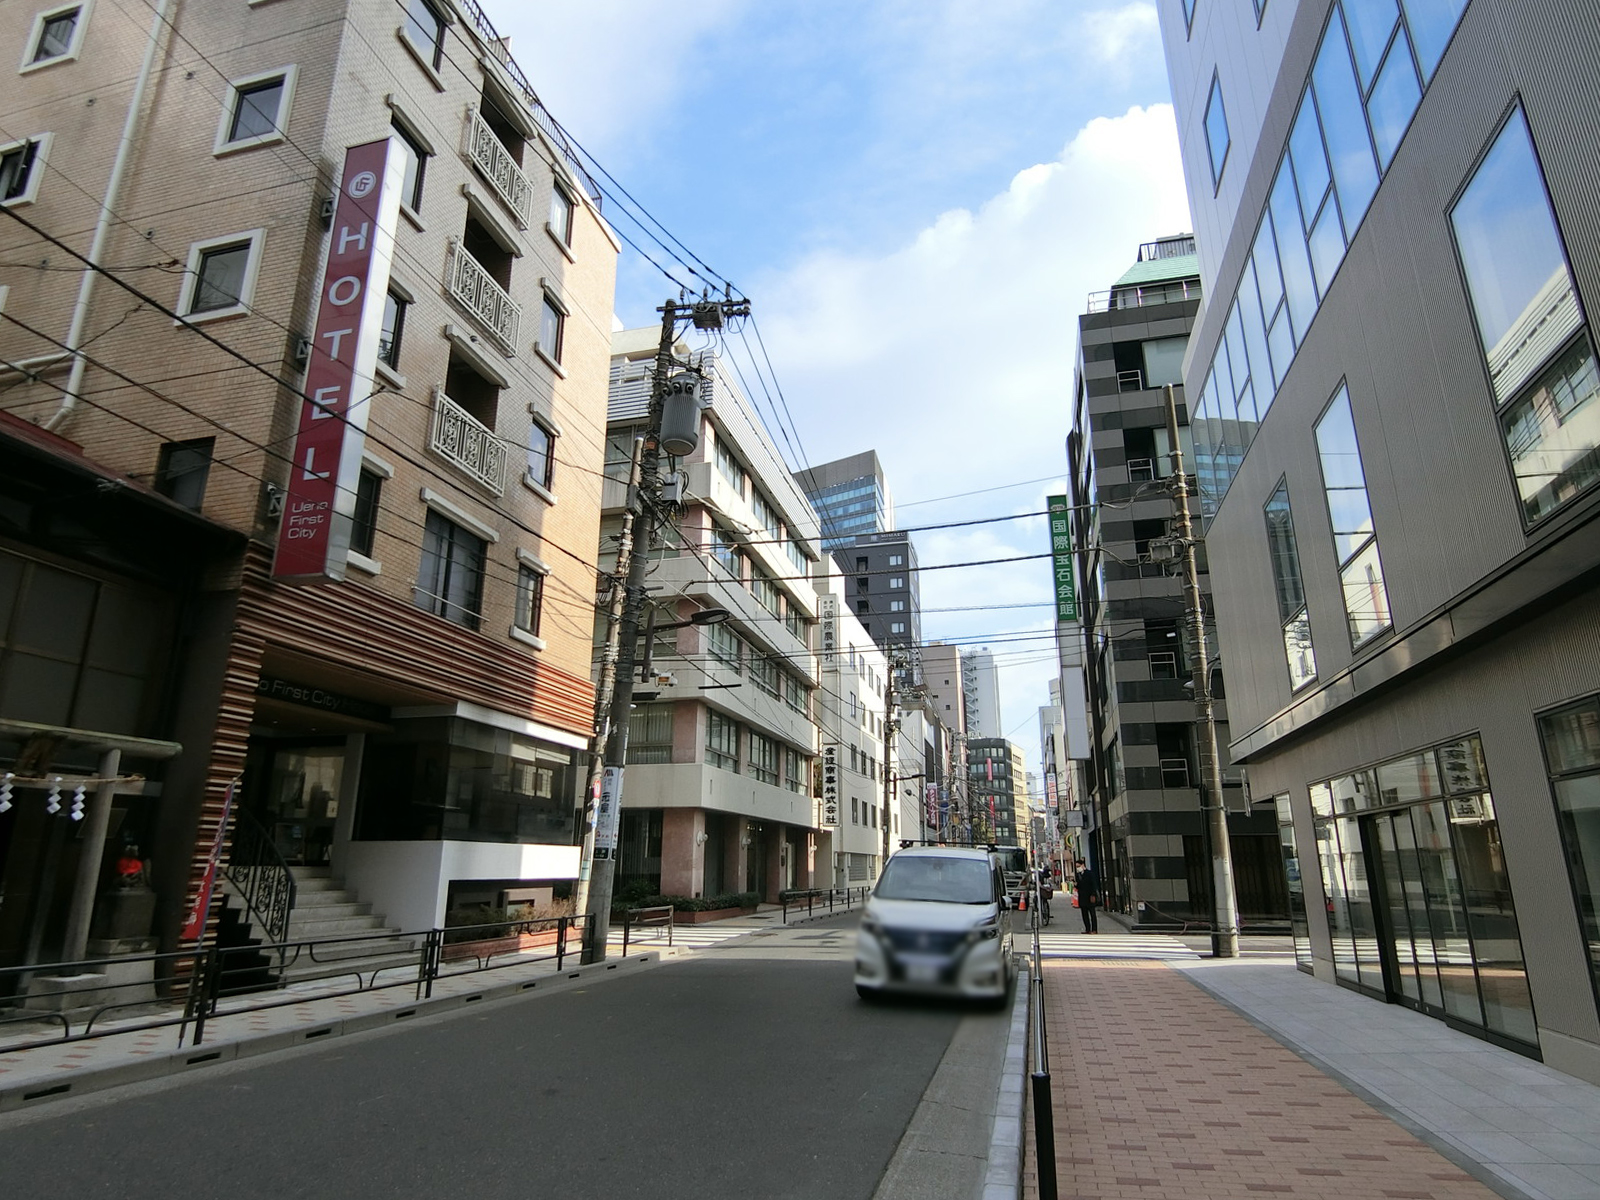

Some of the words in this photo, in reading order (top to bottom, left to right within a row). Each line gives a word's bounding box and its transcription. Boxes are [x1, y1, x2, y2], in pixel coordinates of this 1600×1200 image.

[302, 222, 369, 481] HOTEL
[287, 527, 317, 540] City
[289, 513, 325, 526] First
[1052, 518, 1075, 616] 国際宝石会館
[271, 679, 310, 701] First
[312, 690, 341, 709] City
